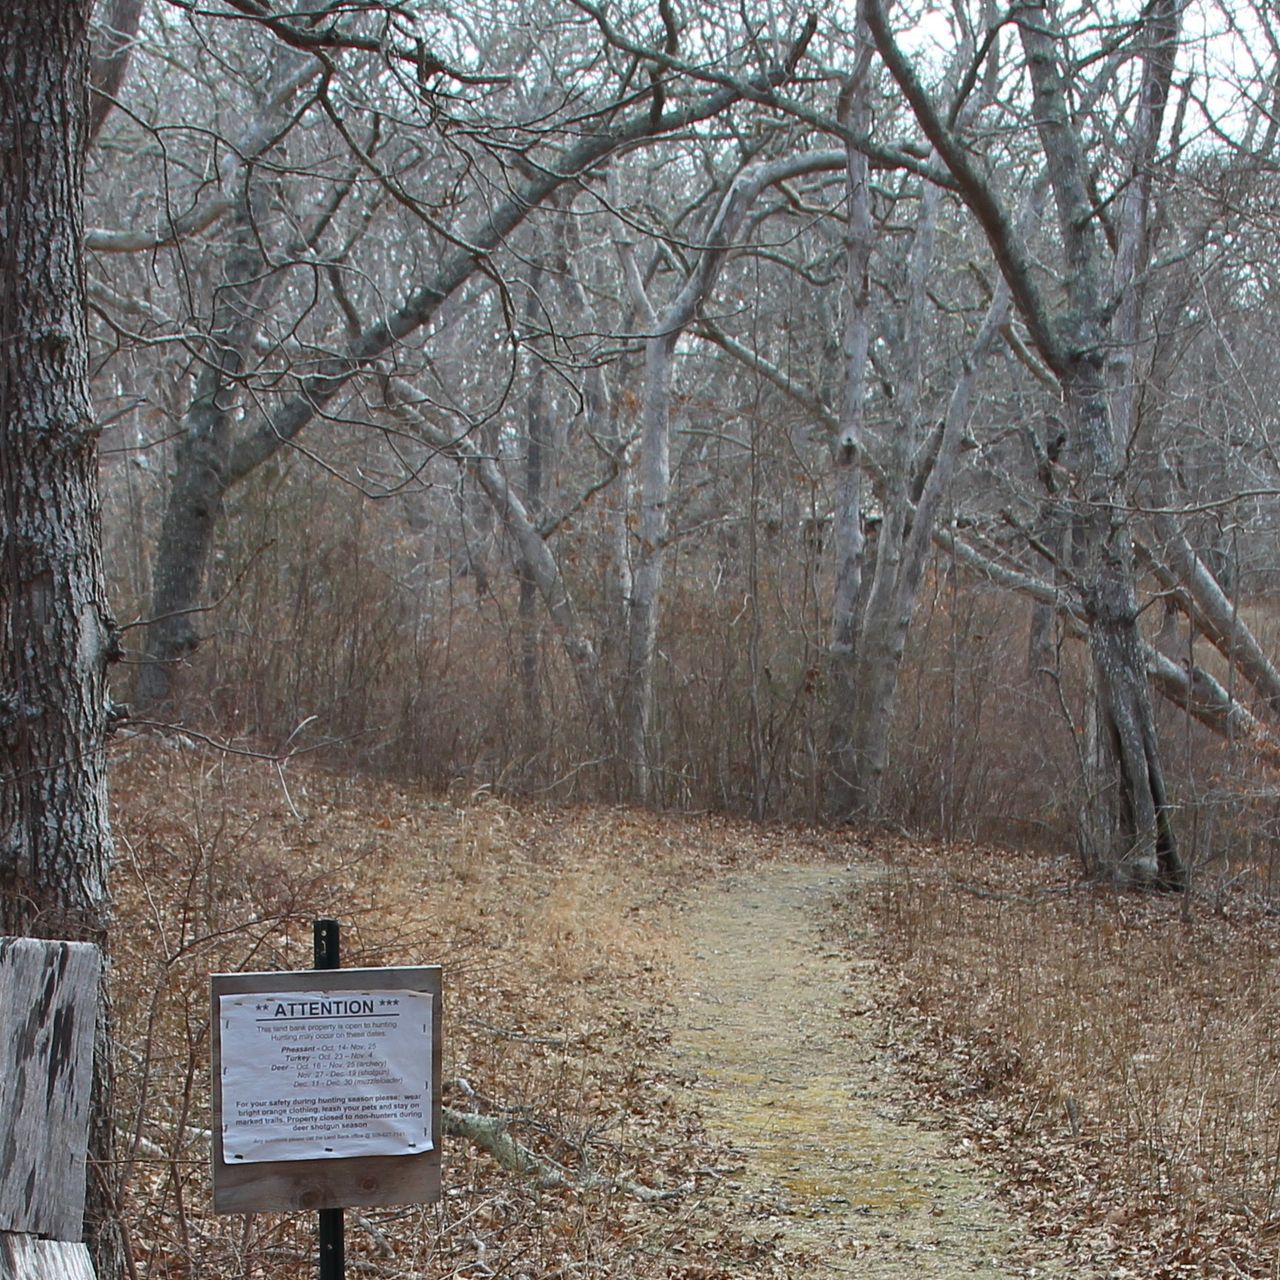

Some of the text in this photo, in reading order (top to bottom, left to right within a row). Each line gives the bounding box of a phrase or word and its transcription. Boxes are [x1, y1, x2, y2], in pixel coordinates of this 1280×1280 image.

[274, 1000, 374, 1017] ATTENTION
[308, 1023, 336, 1032] property
[286, 1054, 310, 1062] Turkey
[251, 1100, 267, 1108] your
[269, 1099, 291, 1107] safety
[318, 1096, 346, 1104] hunting
[238, 1109, 260, 1117] bright
[262, 1108, 287, 1116] orange
[361, 1103, 377, 1111] pets
[394, 1102, 408, 1110] stay
[287, 1115, 318, 1123] Property
[354, 1112, 398, 1120] non-hunters
[399, 1111, 422, 1119] during
[311, 1123, 340, 1131] shotgun
